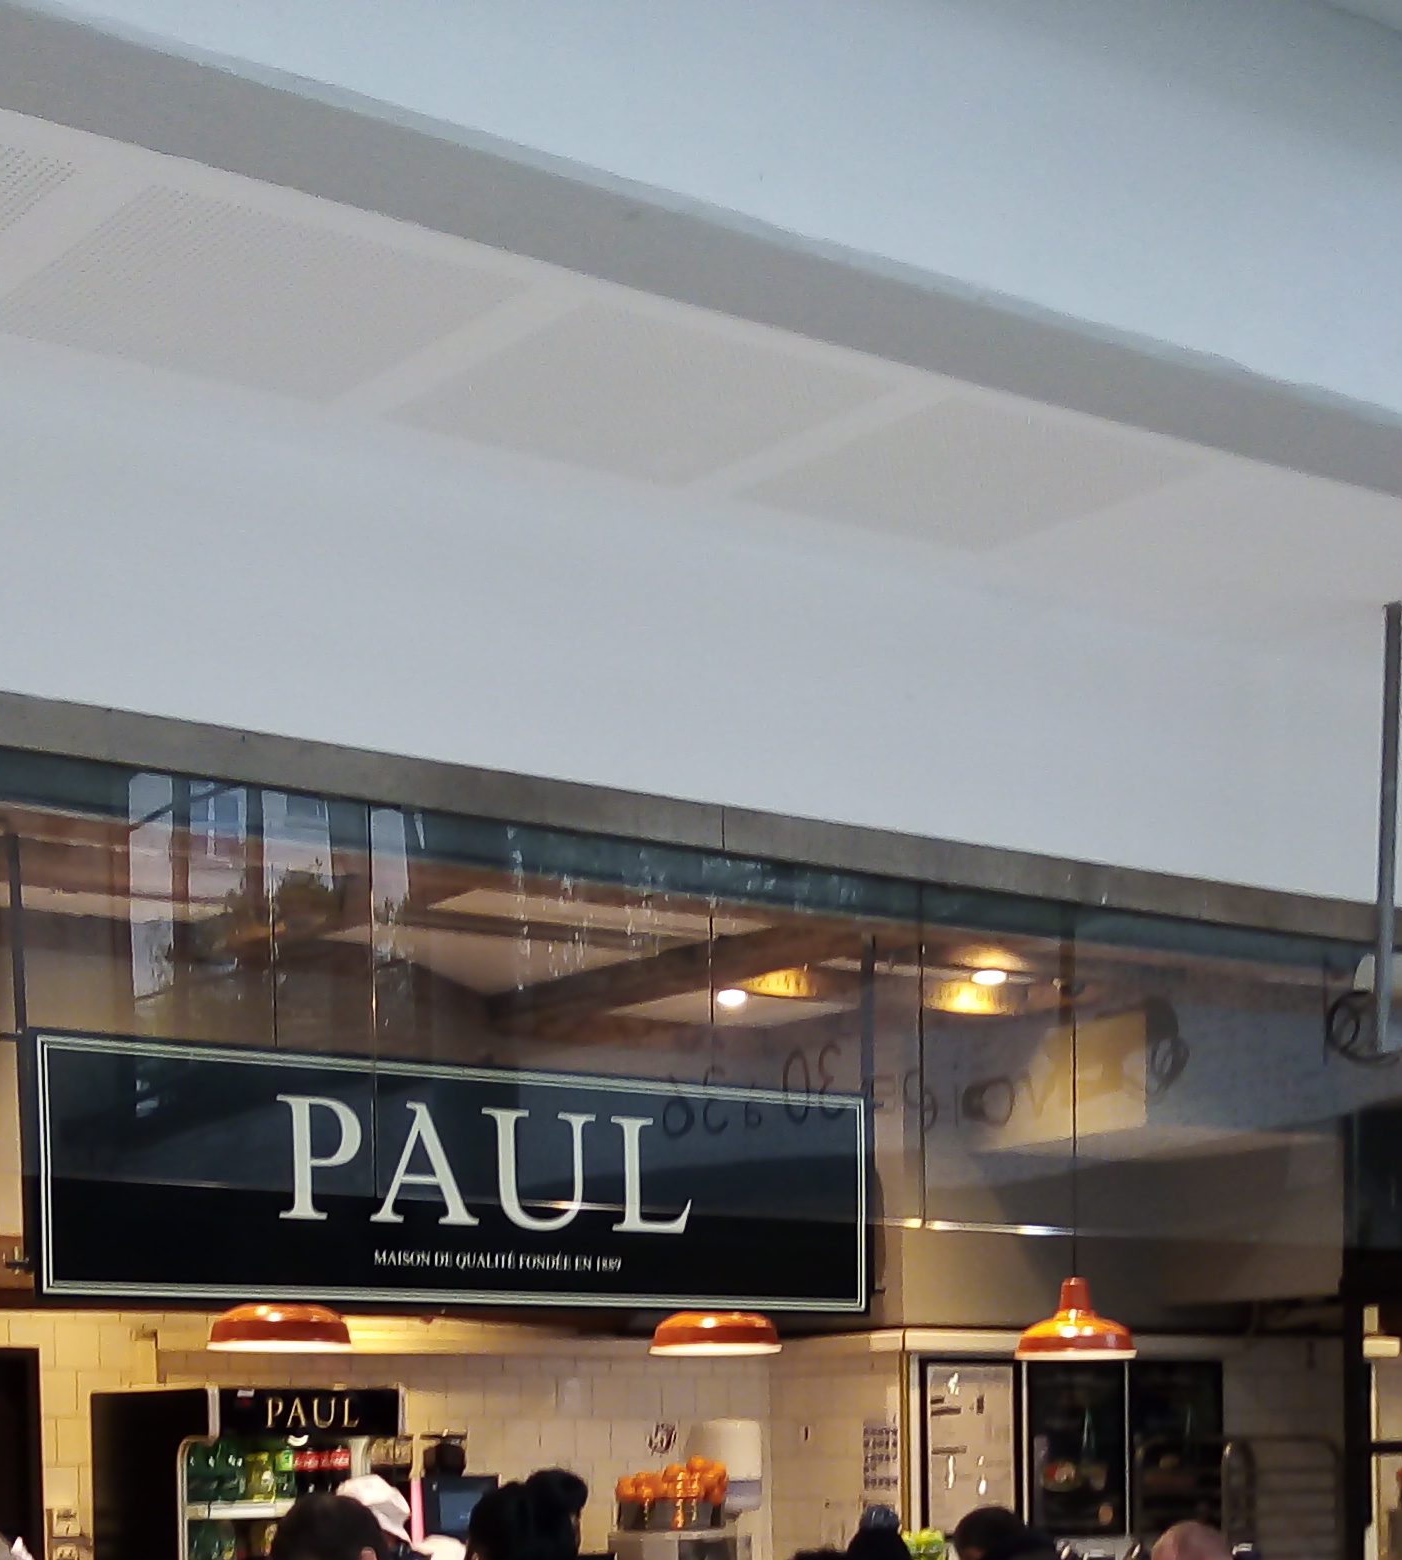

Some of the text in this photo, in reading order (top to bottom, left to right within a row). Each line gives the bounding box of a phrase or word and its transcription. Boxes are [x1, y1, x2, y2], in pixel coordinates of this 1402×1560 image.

[276, 1094, 692, 1234] PAUL
[373, 1249, 622, 1273] MAISON DE QUALITÉ FONDÉE EN 1889
[266, 1397, 360, 1428] PAUL
